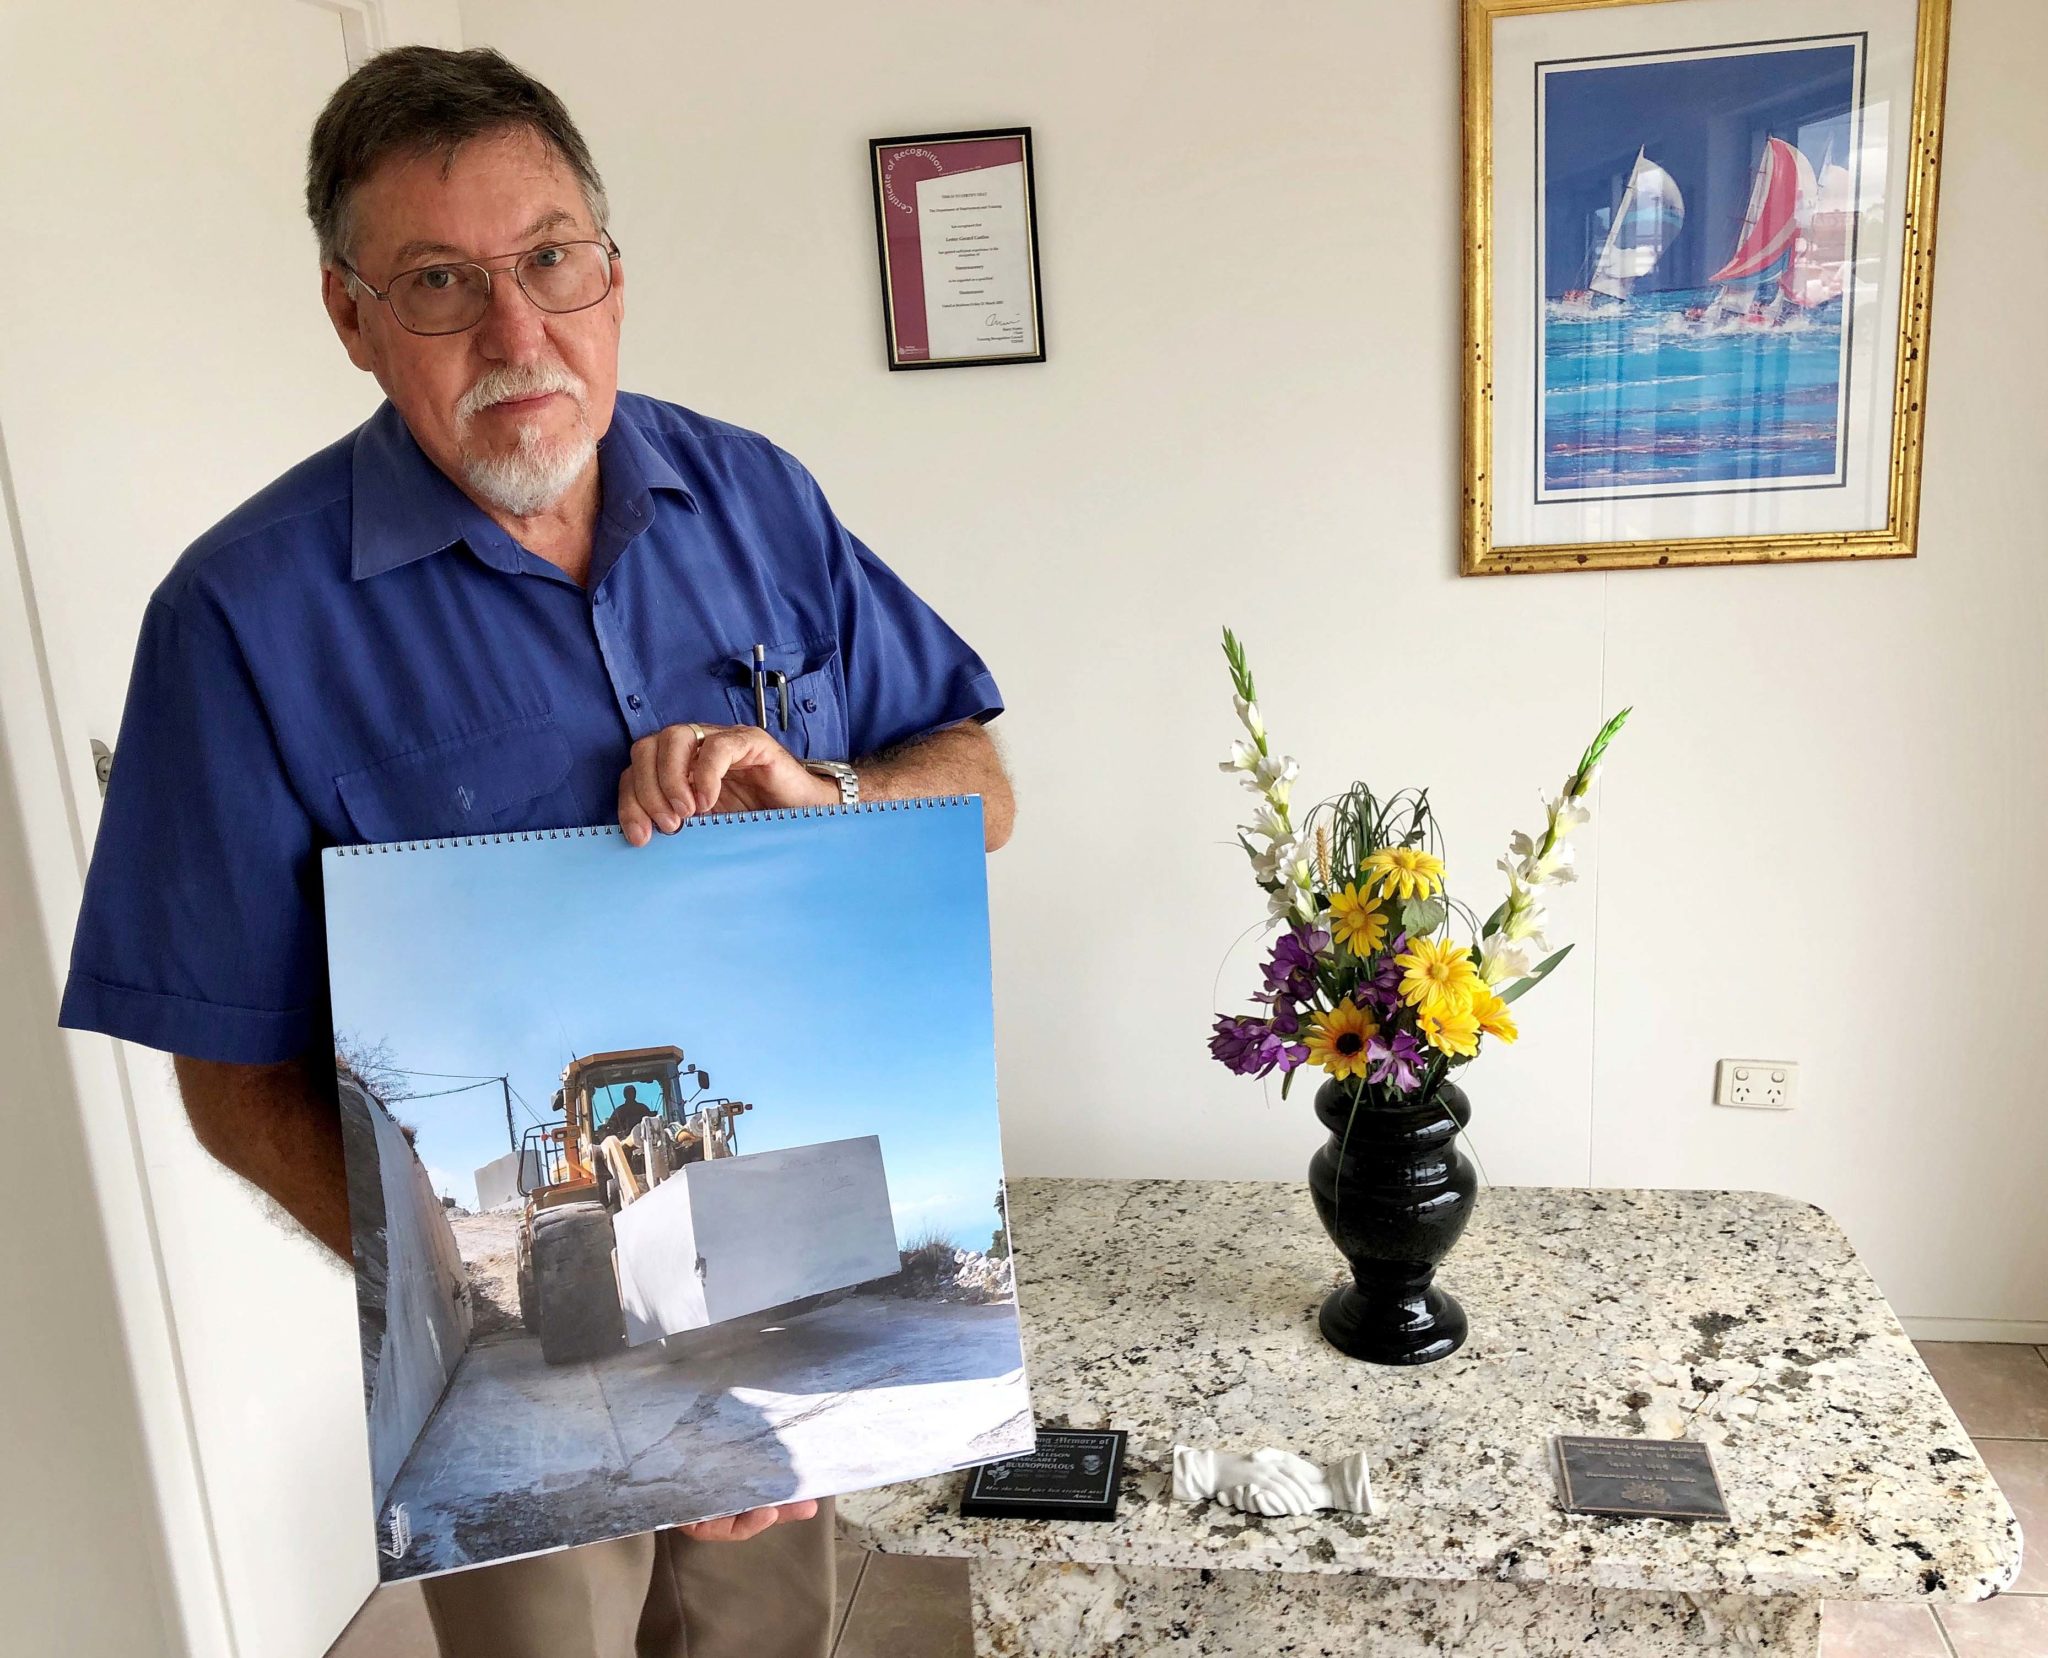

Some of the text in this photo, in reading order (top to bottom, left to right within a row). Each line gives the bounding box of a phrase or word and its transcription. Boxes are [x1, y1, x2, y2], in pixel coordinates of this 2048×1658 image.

[885, 148, 943, 214] Certificate of Recognition
[1055, 1437, 1097, 1445] Memory
[1099, 1438, 1110, 1446] of
[389, 1520, 400, 1553] musetti
